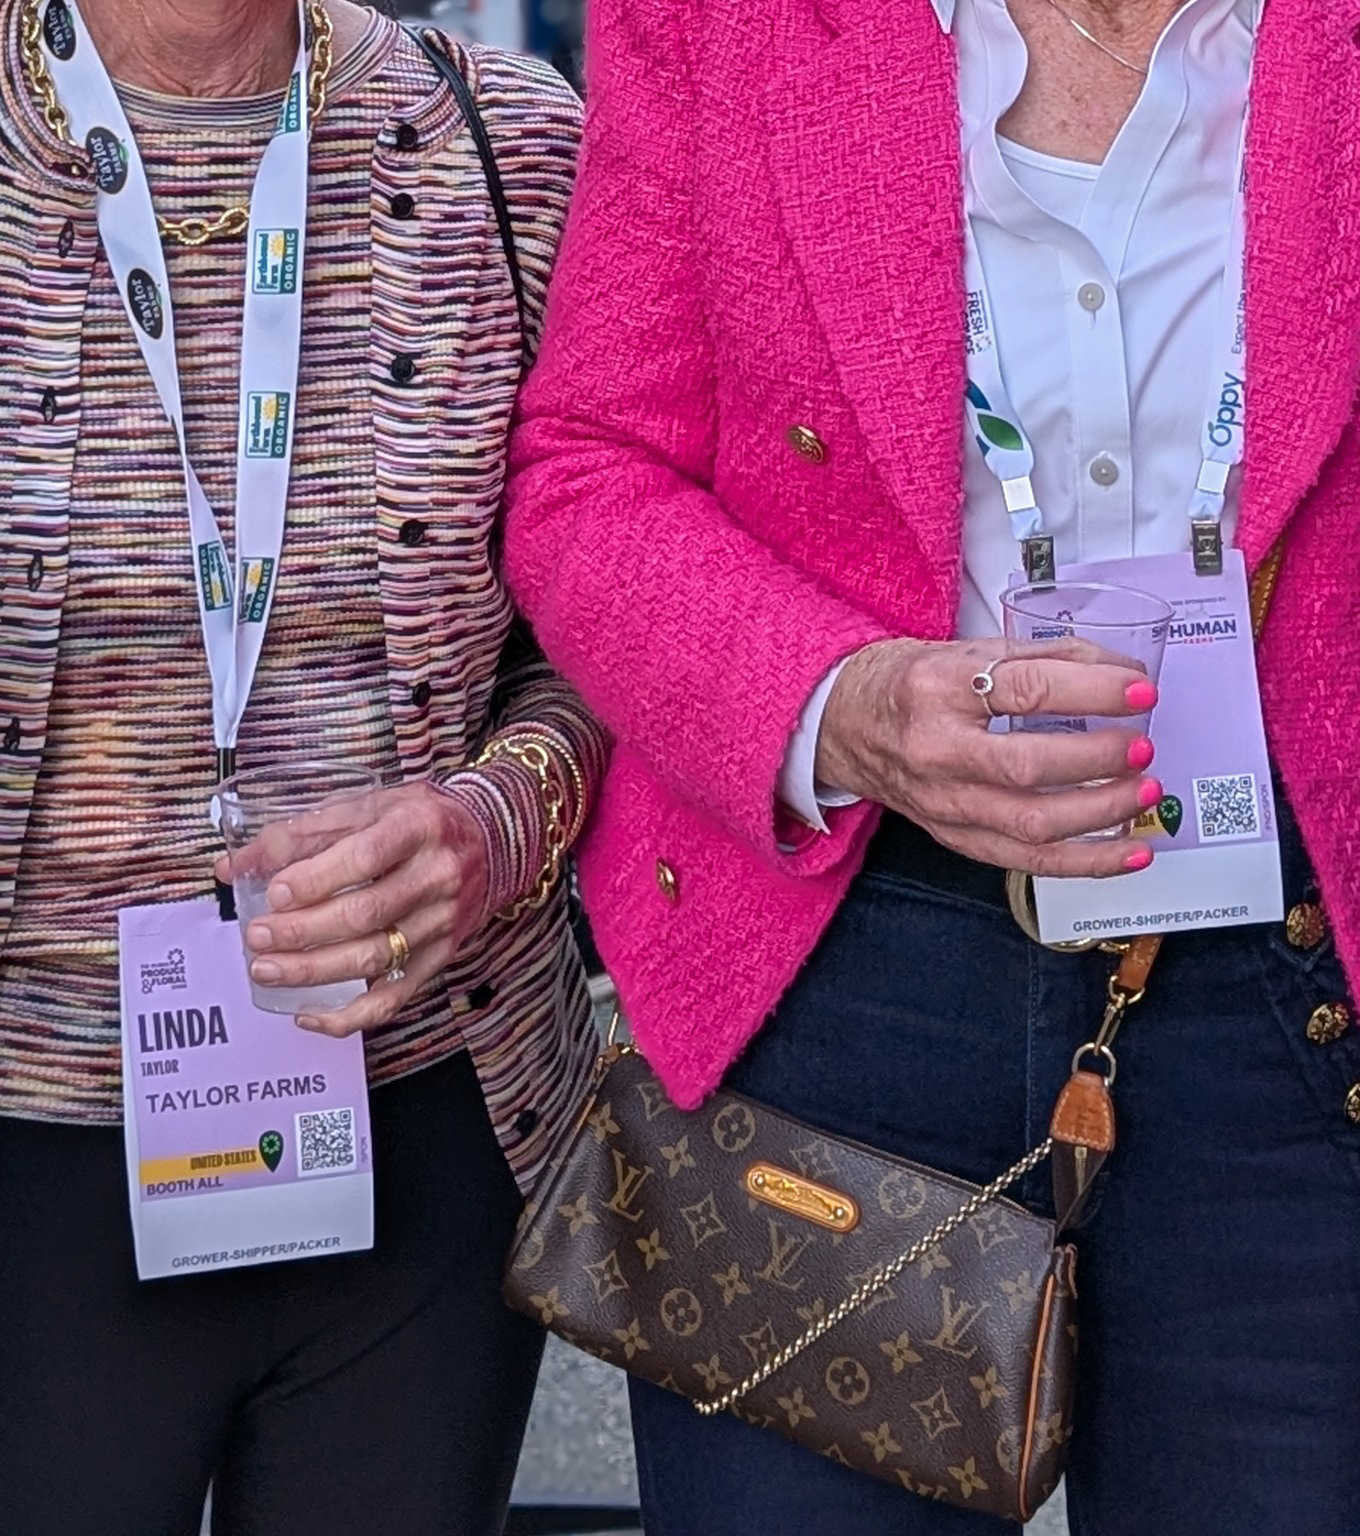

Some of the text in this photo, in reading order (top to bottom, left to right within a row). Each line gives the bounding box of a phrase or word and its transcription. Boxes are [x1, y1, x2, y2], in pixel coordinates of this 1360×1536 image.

[48, 6, 66, 55] Taylor
[91, 137, 115, 187] Taylor
[107, 142, 124, 173] FARMS
[283, 233, 296, 290] ORGANIC
[131, 279, 155, 331] Taylor
[967, 291, 984, 336] FRESH
[274, 396, 287, 454] ORGANIC
[1208, 371, 1246, 447] Oppy
[252, 563, 271, 619] ORGANIC
[1073, 905, 1249, 933] GROWER-SHIPPER/PACKER
[141, 966, 185, 978] PRODUCE
[151, 975, 186, 986] FLORAL
[138, 1005, 229, 1053] LINDA
[140, 1059, 179, 1077] TAYLOR
[146, 1074, 326, 1114] TAYLOR FARMS
[190, 1150, 257, 1171] UNITED STATES
[146, 1176, 223, 1196] BOOTH ALL
[172, 1236, 341, 1268] GROWER-SHIPPER/PACKER
